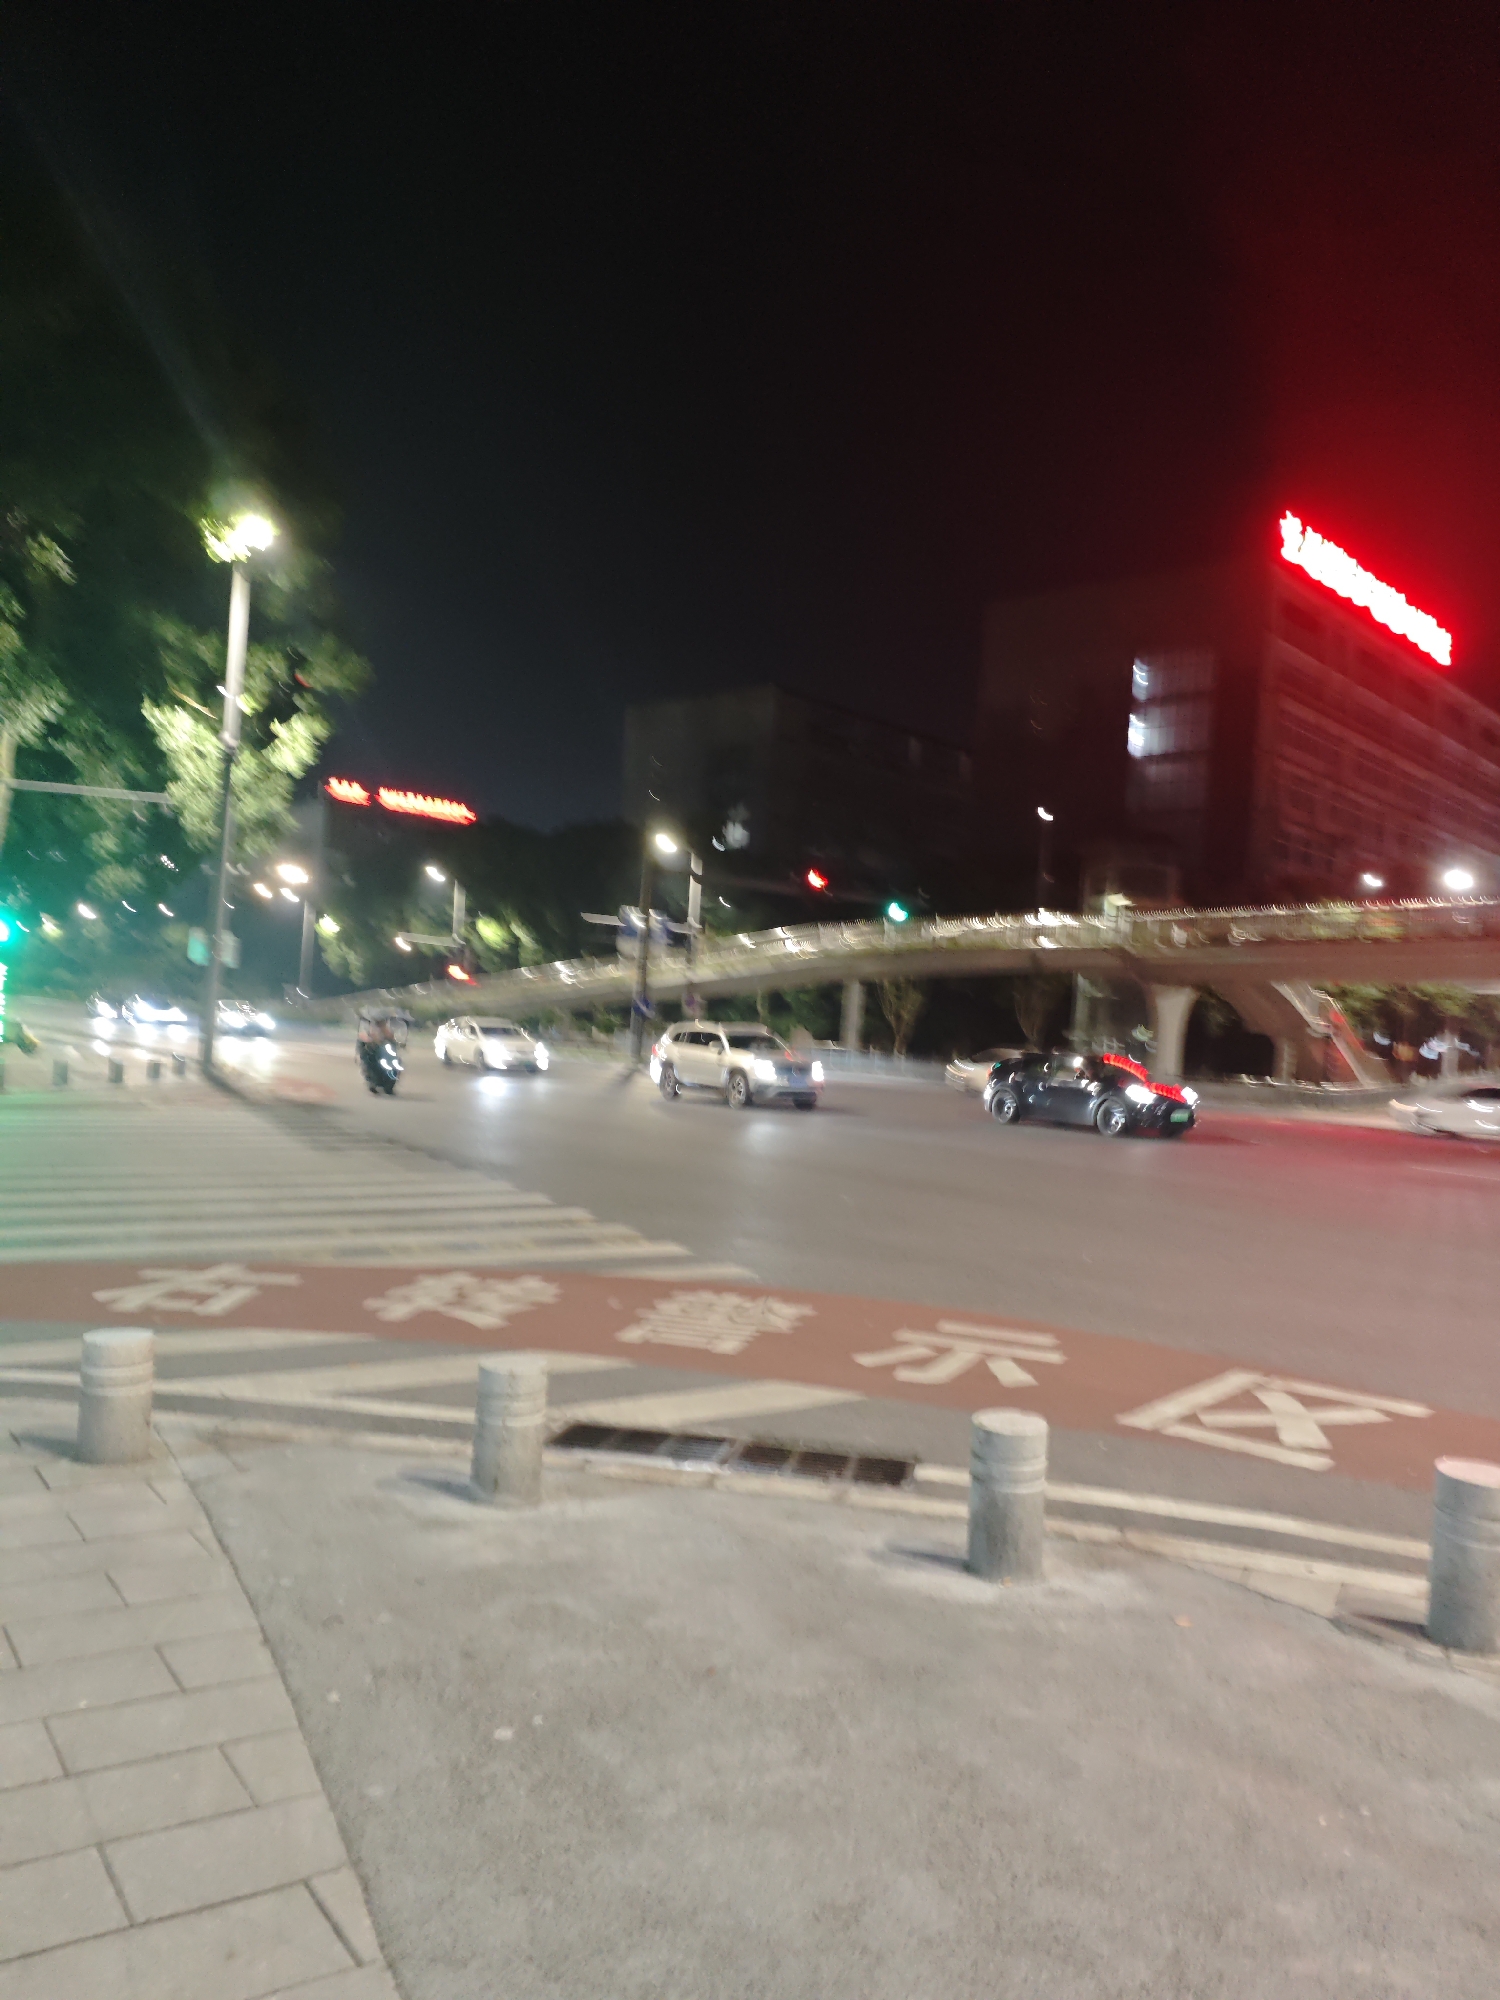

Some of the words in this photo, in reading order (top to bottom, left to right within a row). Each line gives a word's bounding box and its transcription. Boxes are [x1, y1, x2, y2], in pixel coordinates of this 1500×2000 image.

[91, 1263, 1435, 1472] 右转警示区
